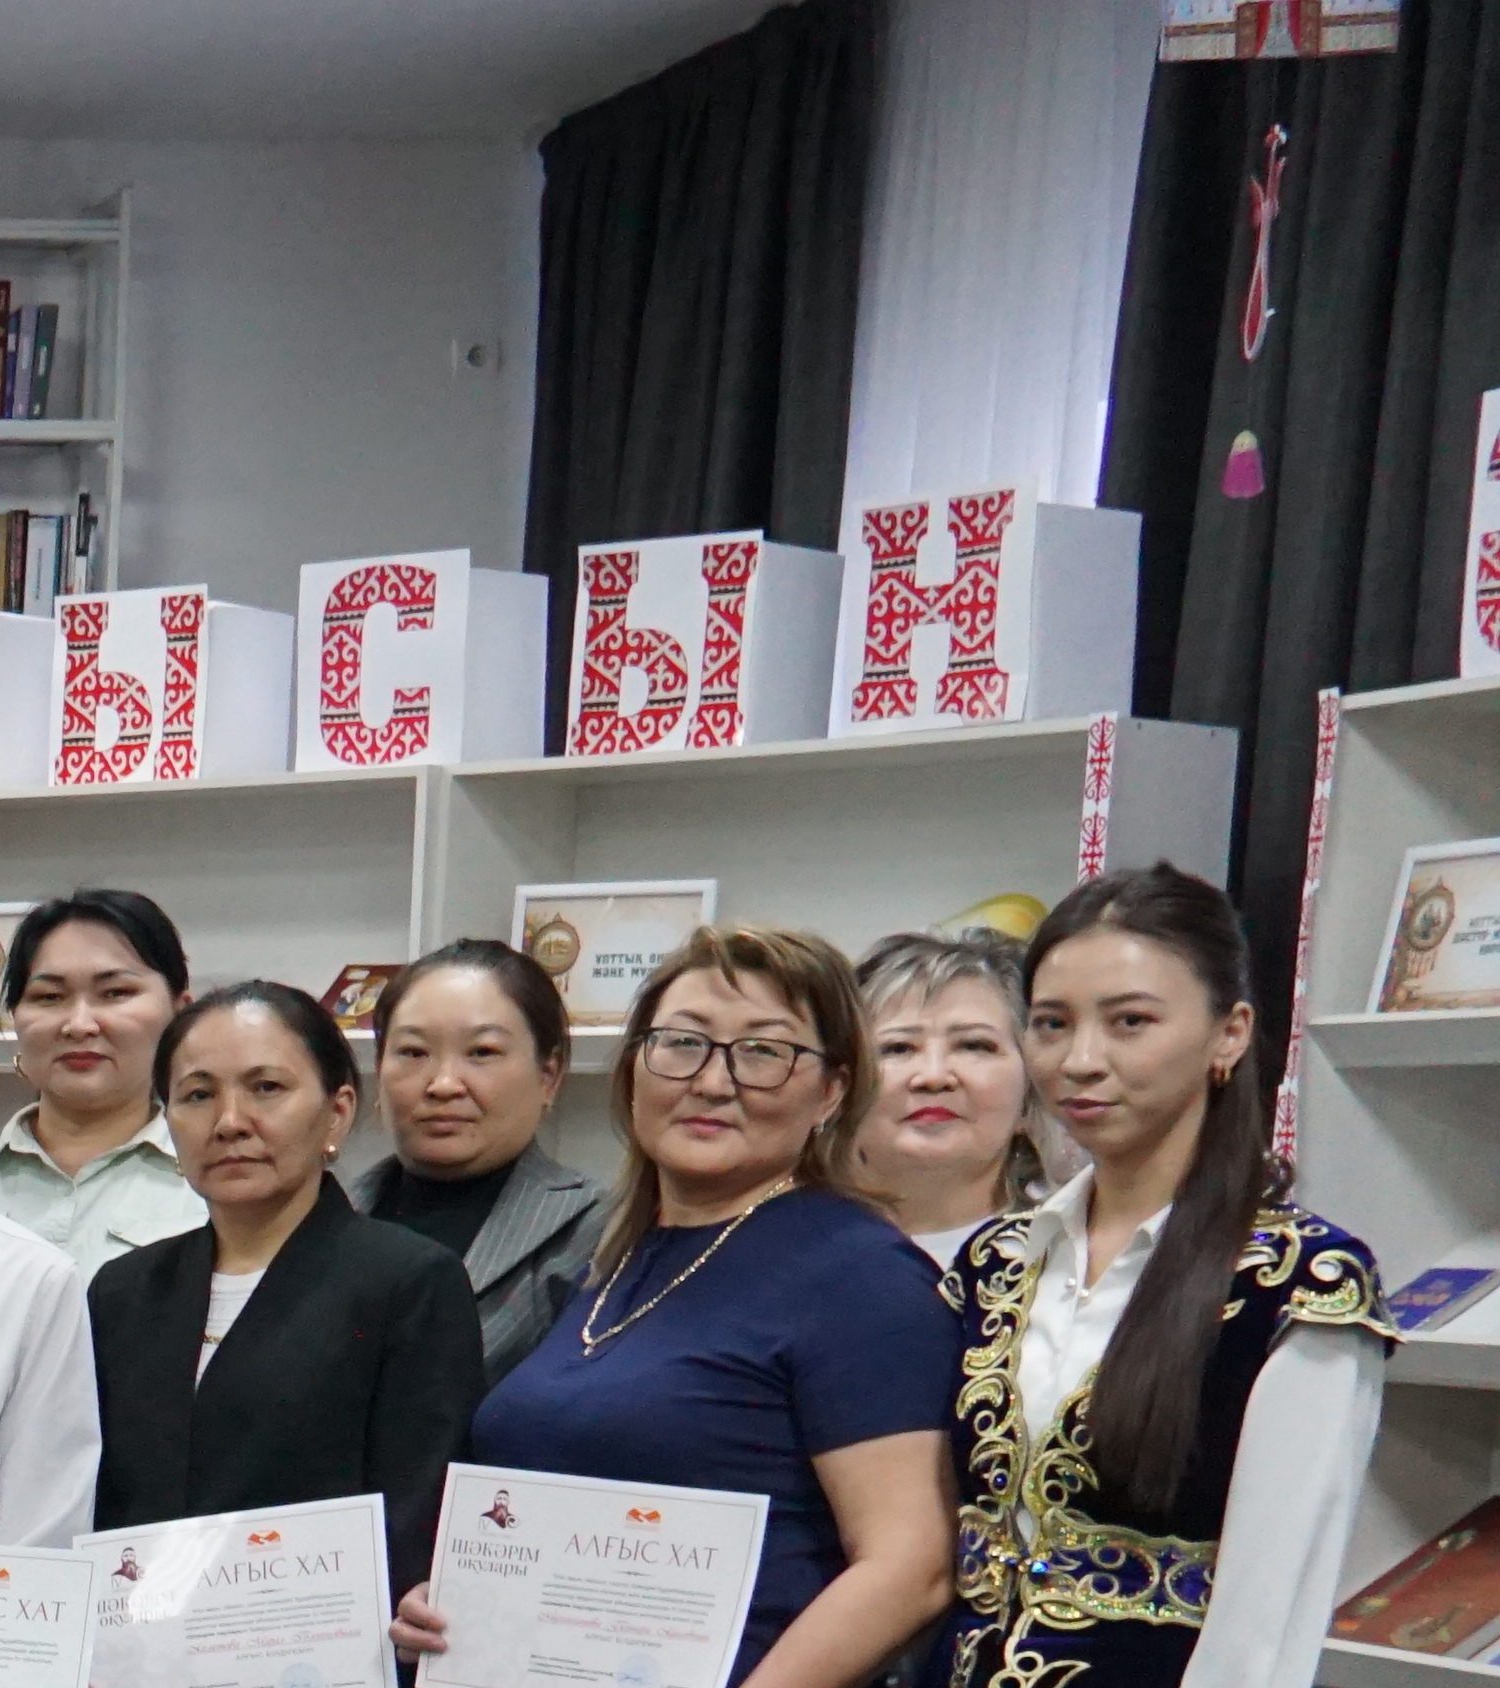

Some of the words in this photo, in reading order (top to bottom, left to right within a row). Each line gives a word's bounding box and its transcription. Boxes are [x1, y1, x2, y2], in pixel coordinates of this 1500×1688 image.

[296, 1551, 345, 1576] ХАТ
[667, 1543, 720, 1571] ХАТ
[15, 1598, 67, 1623] ХАТ
